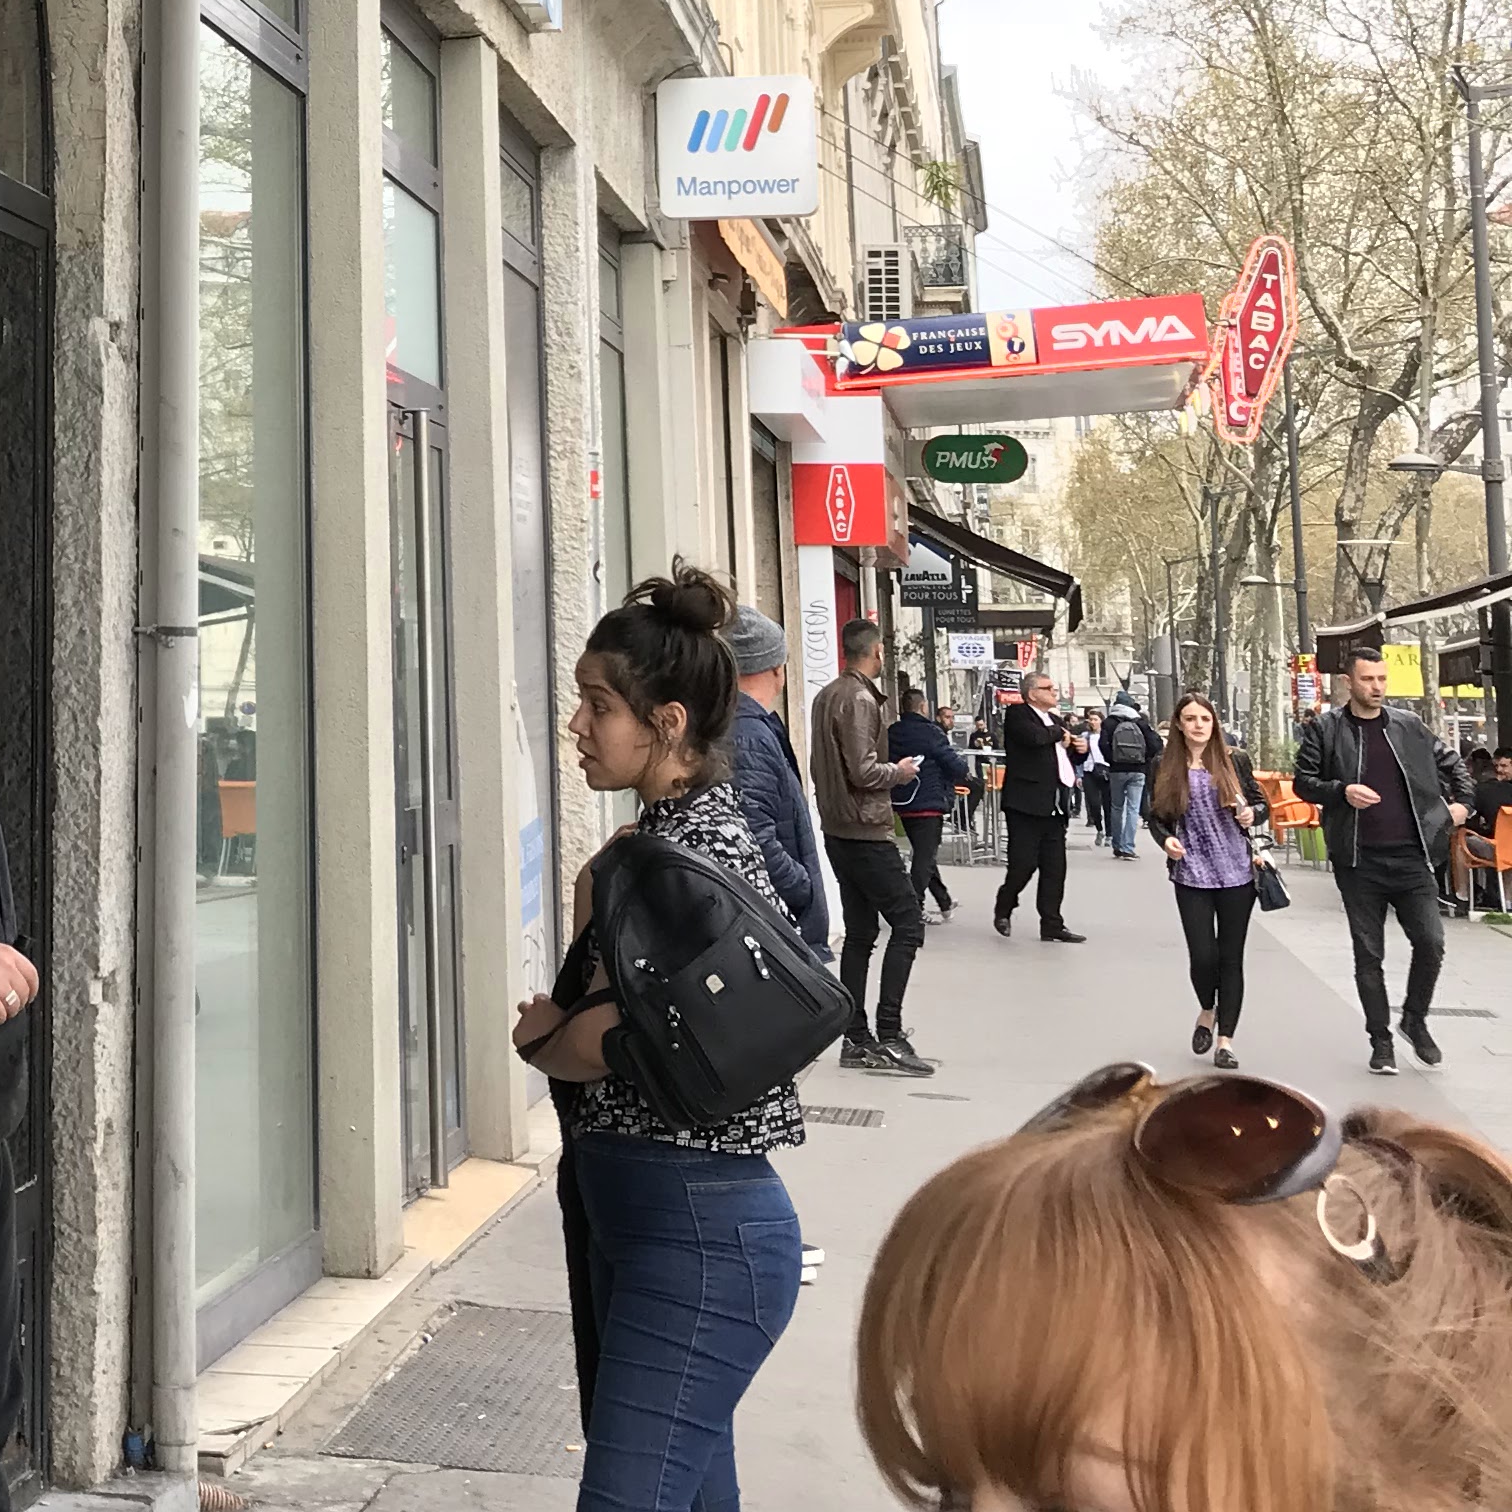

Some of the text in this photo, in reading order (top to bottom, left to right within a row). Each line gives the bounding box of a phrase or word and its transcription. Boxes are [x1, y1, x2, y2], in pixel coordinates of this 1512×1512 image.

[676, 176, 799, 200] Manpower
[1248, 273, 1278, 370] TABAC
[912, 326, 986, 342] FRANÇAISE
[1051, 315, 1196, 350] SYMA
[919, 341, 983, 355] DES JEUX
[935, 451, 982, 469] PMU
[835, 473, 848, 533] TABAC
[904, 591, 958, 600] POUR TOUS
